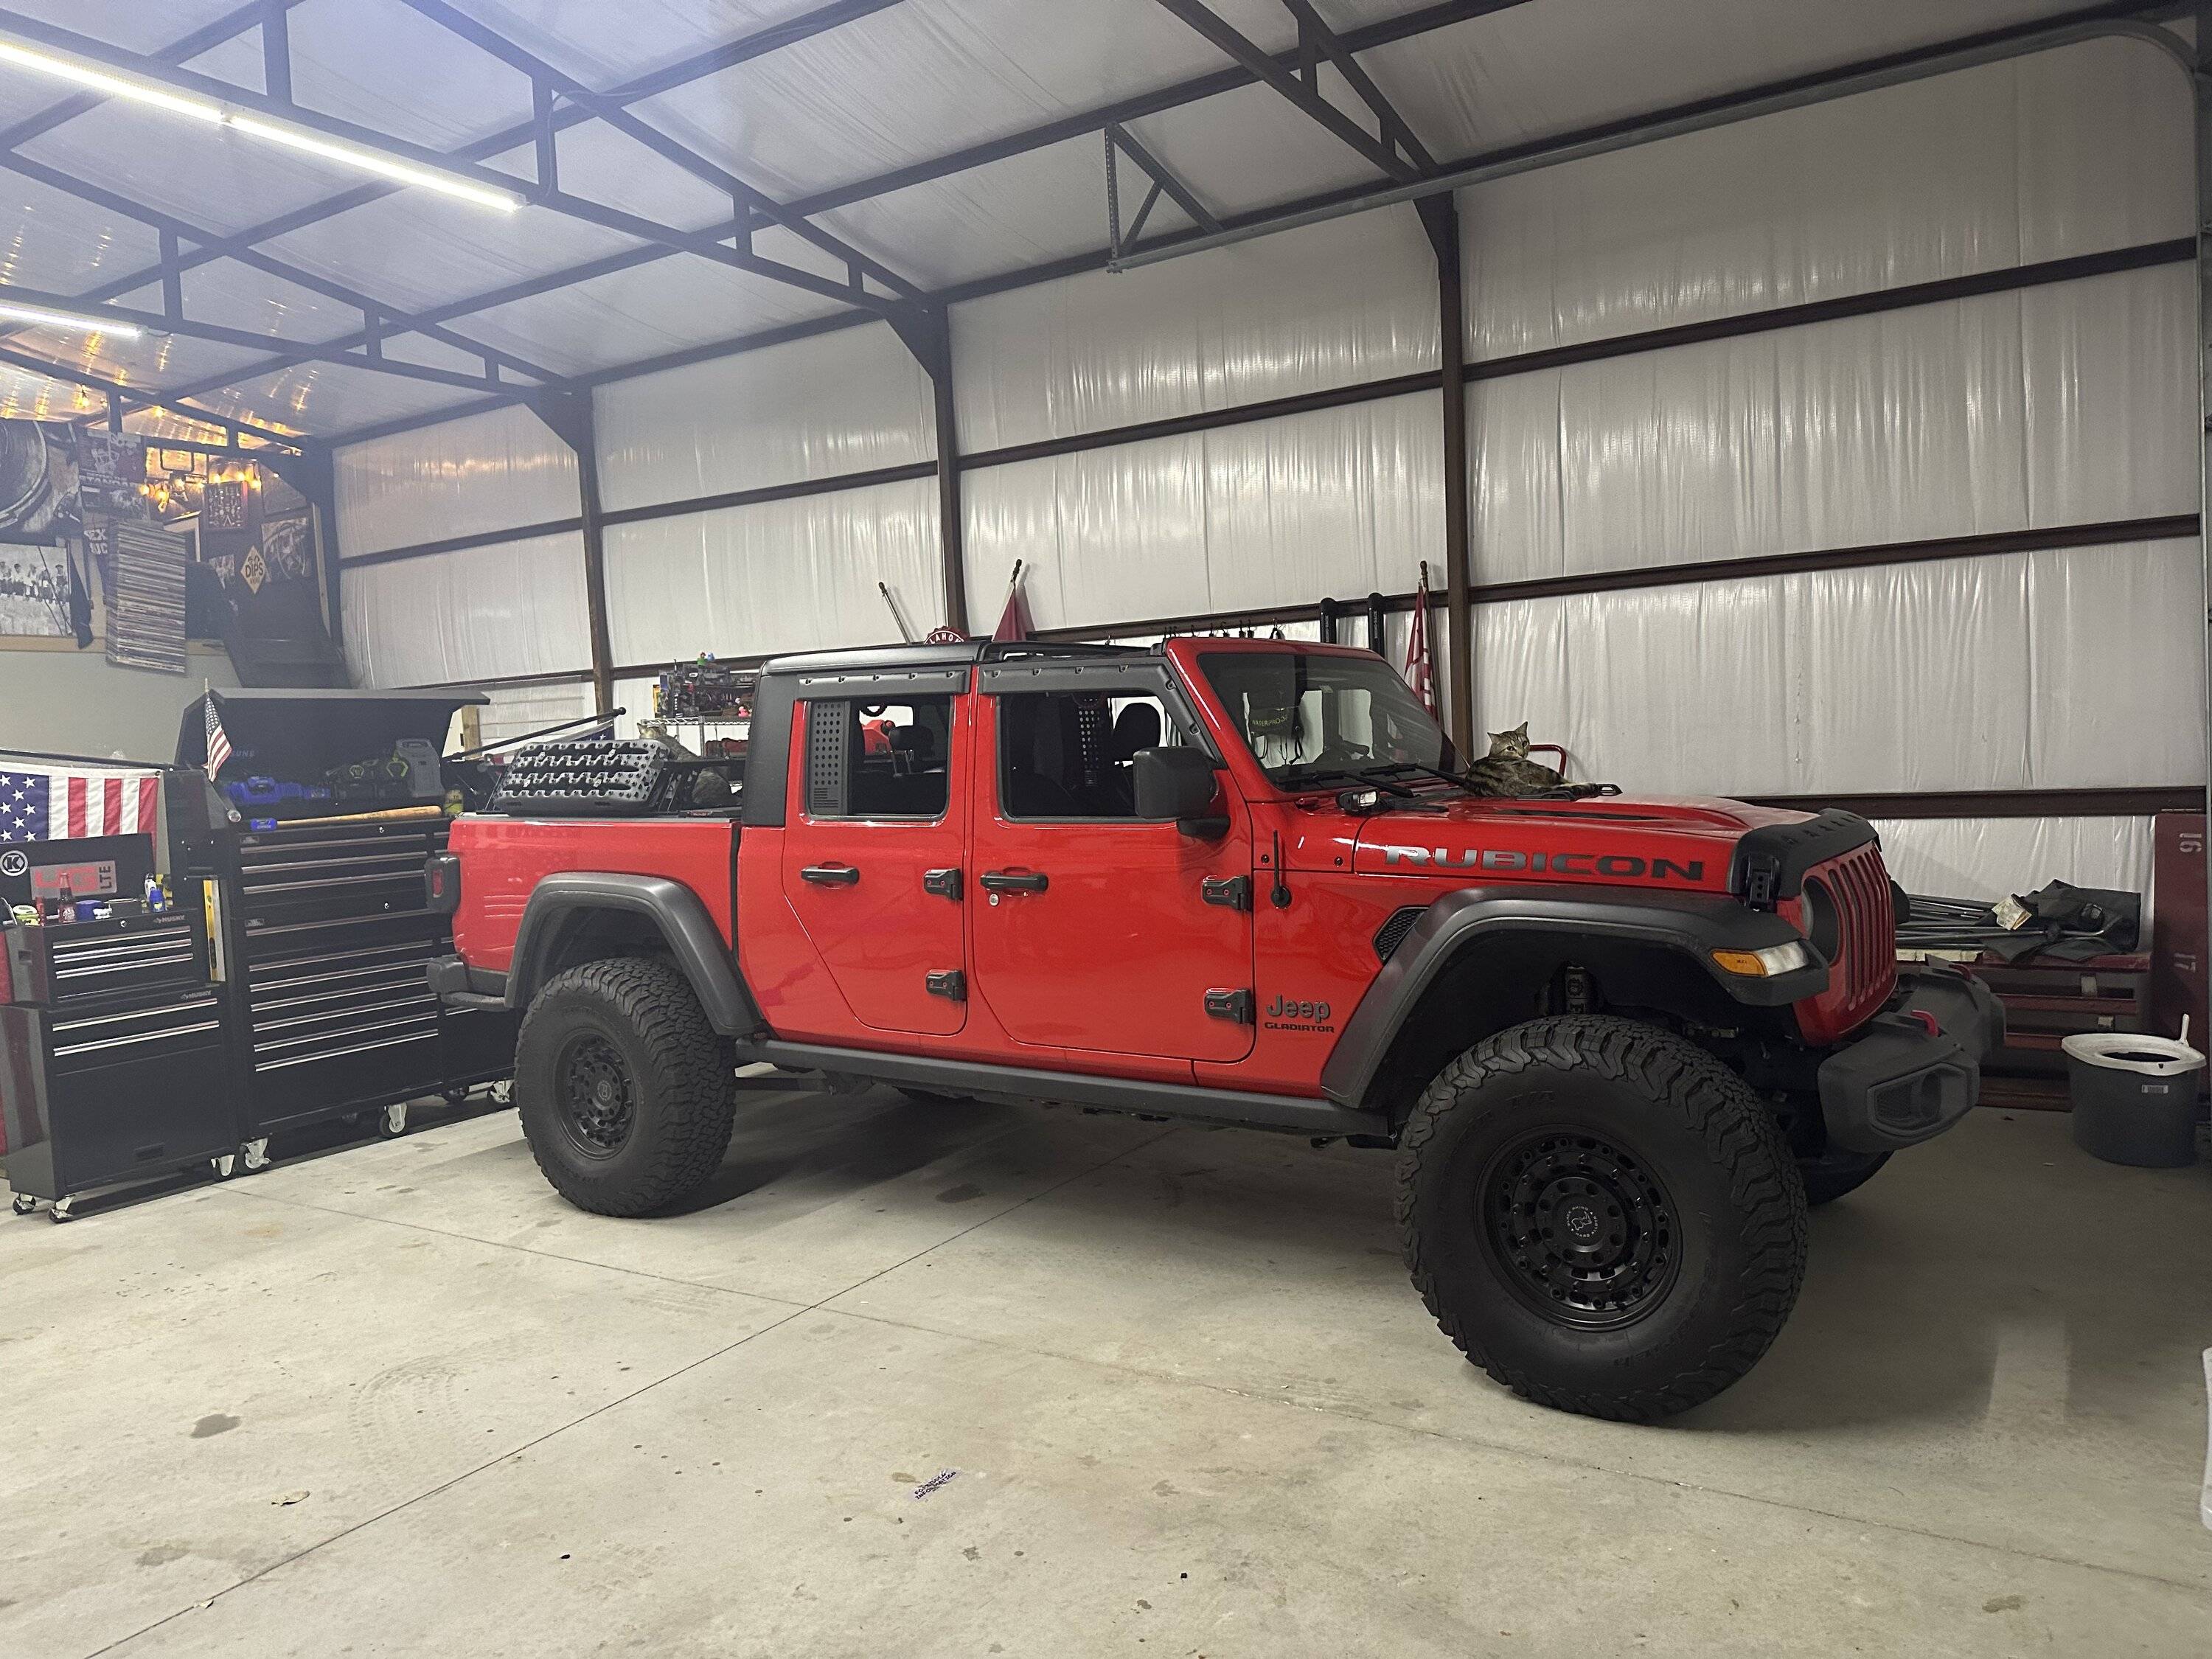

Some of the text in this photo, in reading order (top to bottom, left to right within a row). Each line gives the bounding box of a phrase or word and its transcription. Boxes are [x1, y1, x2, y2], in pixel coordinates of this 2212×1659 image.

[245, 562, 263, 578] DIPS
[928, 633, 961, 644] LAHO
[2179, 832, 2202, 853] 16
[1385, 846, 1705, 881] RUBICON
[34, 865, 113, 893] 4G LTE
[161, 914, 186, 923] HUSKY
[2174, 952, 2196, 973] 17
[1266, 995, 1331, 1023] Jeep
[1264, 1021, 1335, 1034] GLADIATOR
